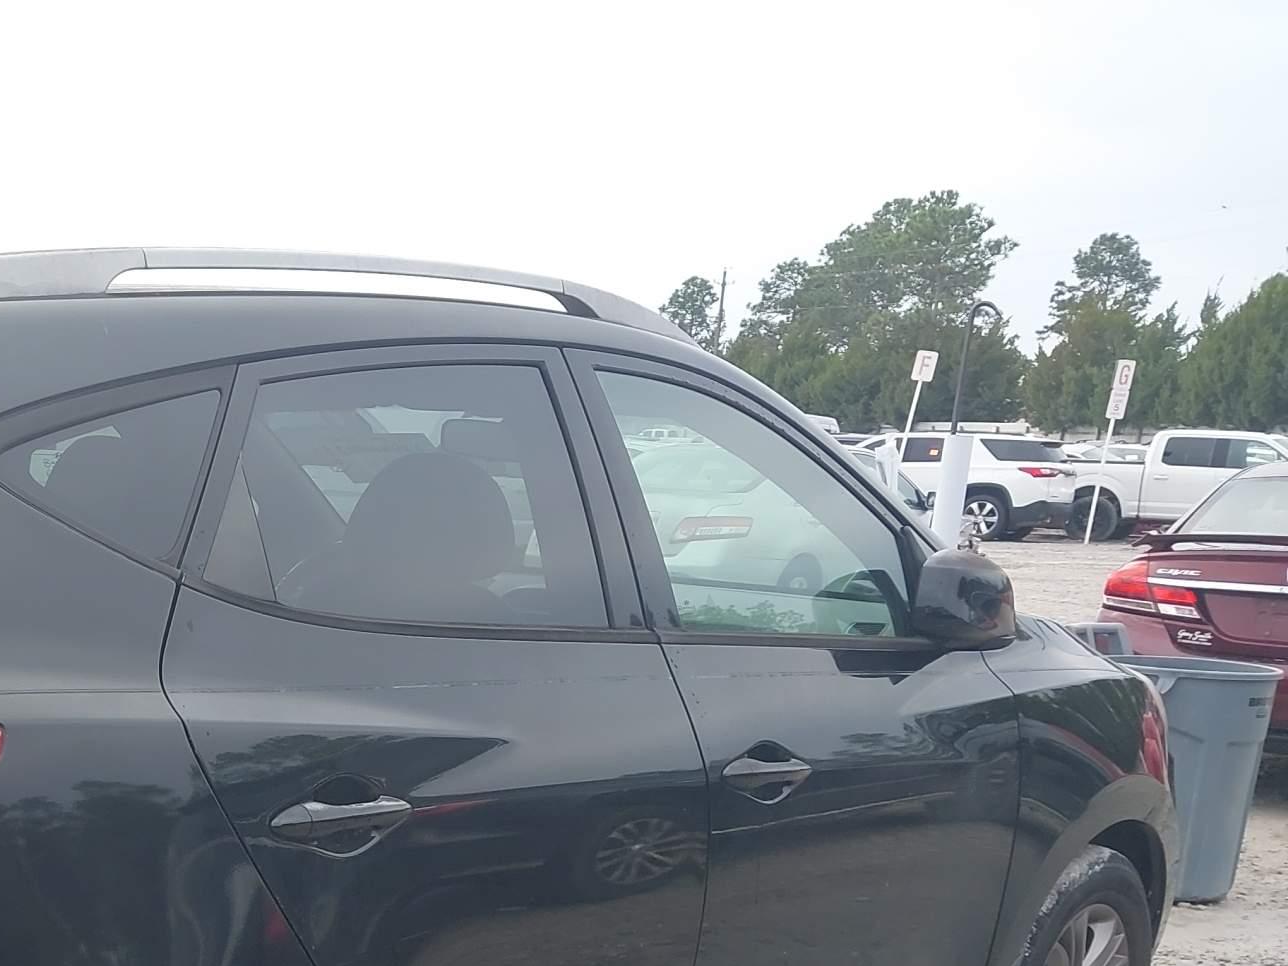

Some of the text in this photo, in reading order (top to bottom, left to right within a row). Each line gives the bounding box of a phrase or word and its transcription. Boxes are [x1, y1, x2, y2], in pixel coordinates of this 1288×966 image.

[919, 355, 932, 375] F
[1119, 364, 1131, 385] G
[1156, 568, 1202, 576] CIVIC
